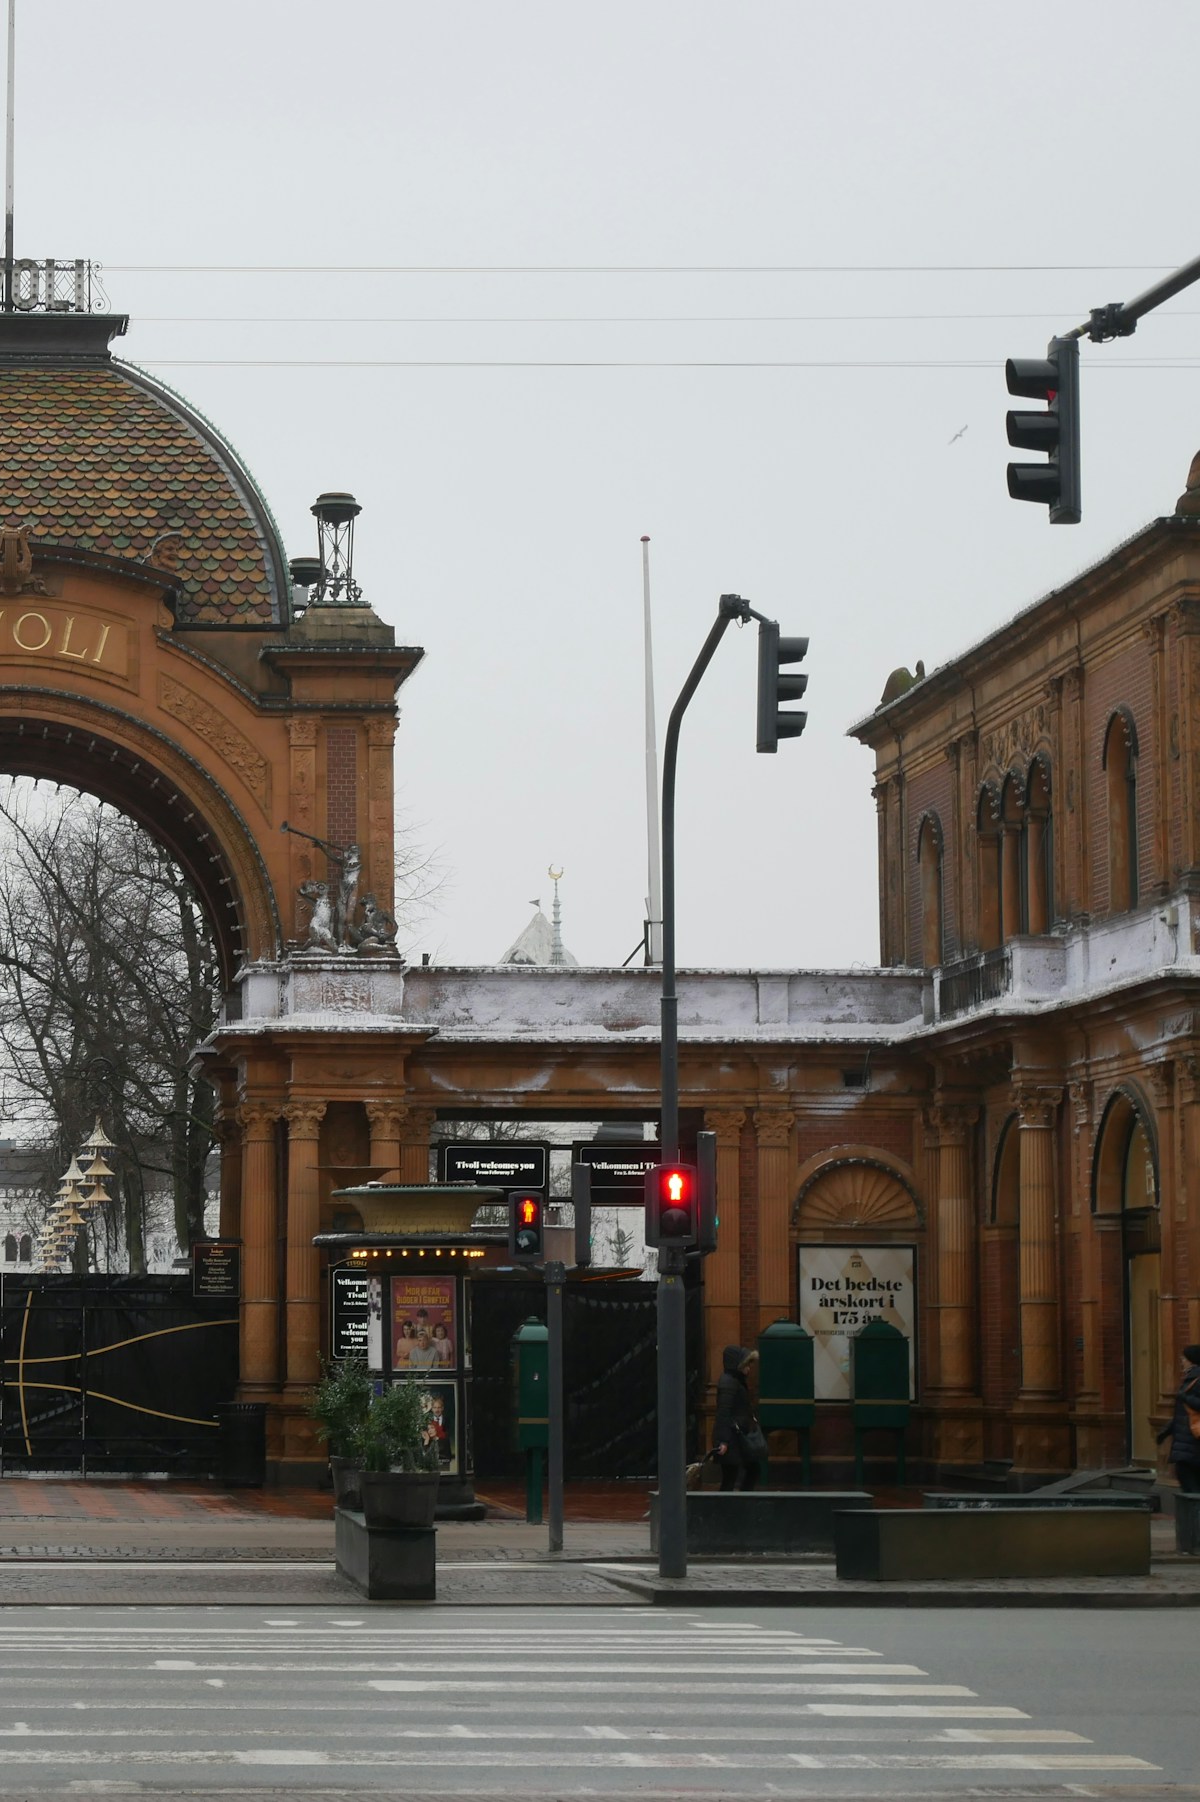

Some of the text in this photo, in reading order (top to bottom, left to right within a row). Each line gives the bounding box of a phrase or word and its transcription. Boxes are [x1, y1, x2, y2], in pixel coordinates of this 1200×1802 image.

[455, 1161, 535, 1171] Tivoli welcomes you
[811, 1277, 903, 1291] Det bedste
[819, 1294, 895, 1308] årskort i
[833, 1311, 859, 1325] 175
